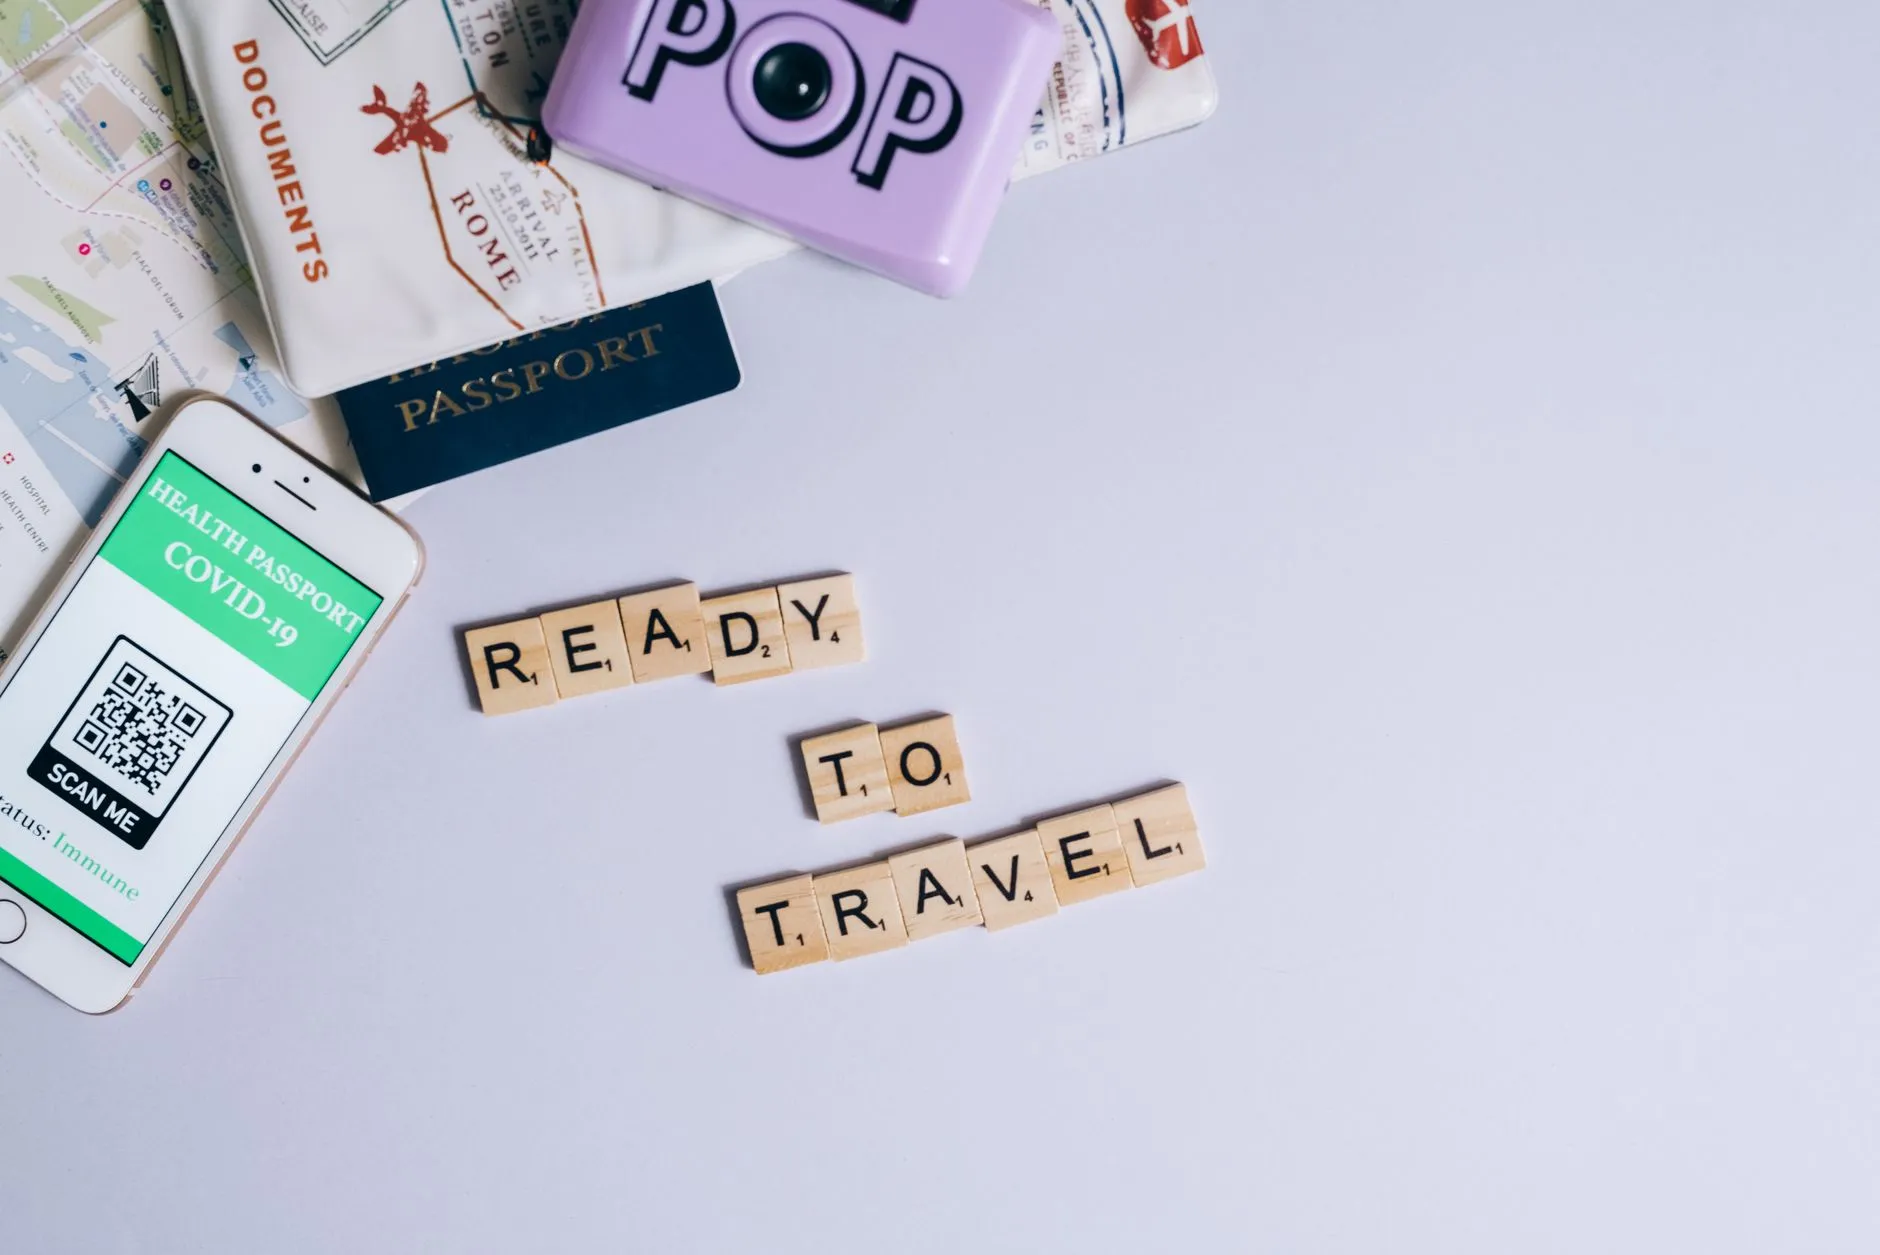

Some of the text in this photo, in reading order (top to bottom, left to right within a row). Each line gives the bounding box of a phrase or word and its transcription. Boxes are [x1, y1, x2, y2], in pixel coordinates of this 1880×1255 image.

[290, 0, 328, 37] AISE
[469, 0, 509, 68] TON
[621, 0, 963, 191] POP
[1053, 61, 1072, 125] REPUBLIC
[233, 39, 329, 284] DOCUMENTS
[451, 187, 523, 292] ROME
[488, 183, 540, 263] 25.10.2011
[498, 169, 562, 264] ARRIVAL
[394, 323, 663, 432] PASSPORT
[0, 489, 50, 554] HEALTH CENTRE
[20, 475, 51, 516] HOSPITAL
[148, 477, 365, 635] HEALTH PASSPORT
[164, 541, 299, 648] COVID-19
[483, 594, 831, 689] READY
[603, 658, 613, 673] 1
[681, 638, 692, 653] 1
[760, 644, 771, 659] 2
[829, 630, 840, 645] 4
[529, 671, 539, 686] 1
[818, 741, 943, 797] TO
[859, 783, 868, 798] 1
[943, 771, 952, 786] 1
[47, 763, 140, 834] SCAN ME
[0, 795, 140, 902] atus: Immune
[1102, 862, 1111, 876] 1
[1174, 842, 1184, 856] 1
[754, 817, 1172, 947] TRAVEL
[955, 894, 964, 908] 1
[1024, 889, 1034, 904] 4
[796, 931, 805, 946] 1
[878, 917, 887, 932] 1
